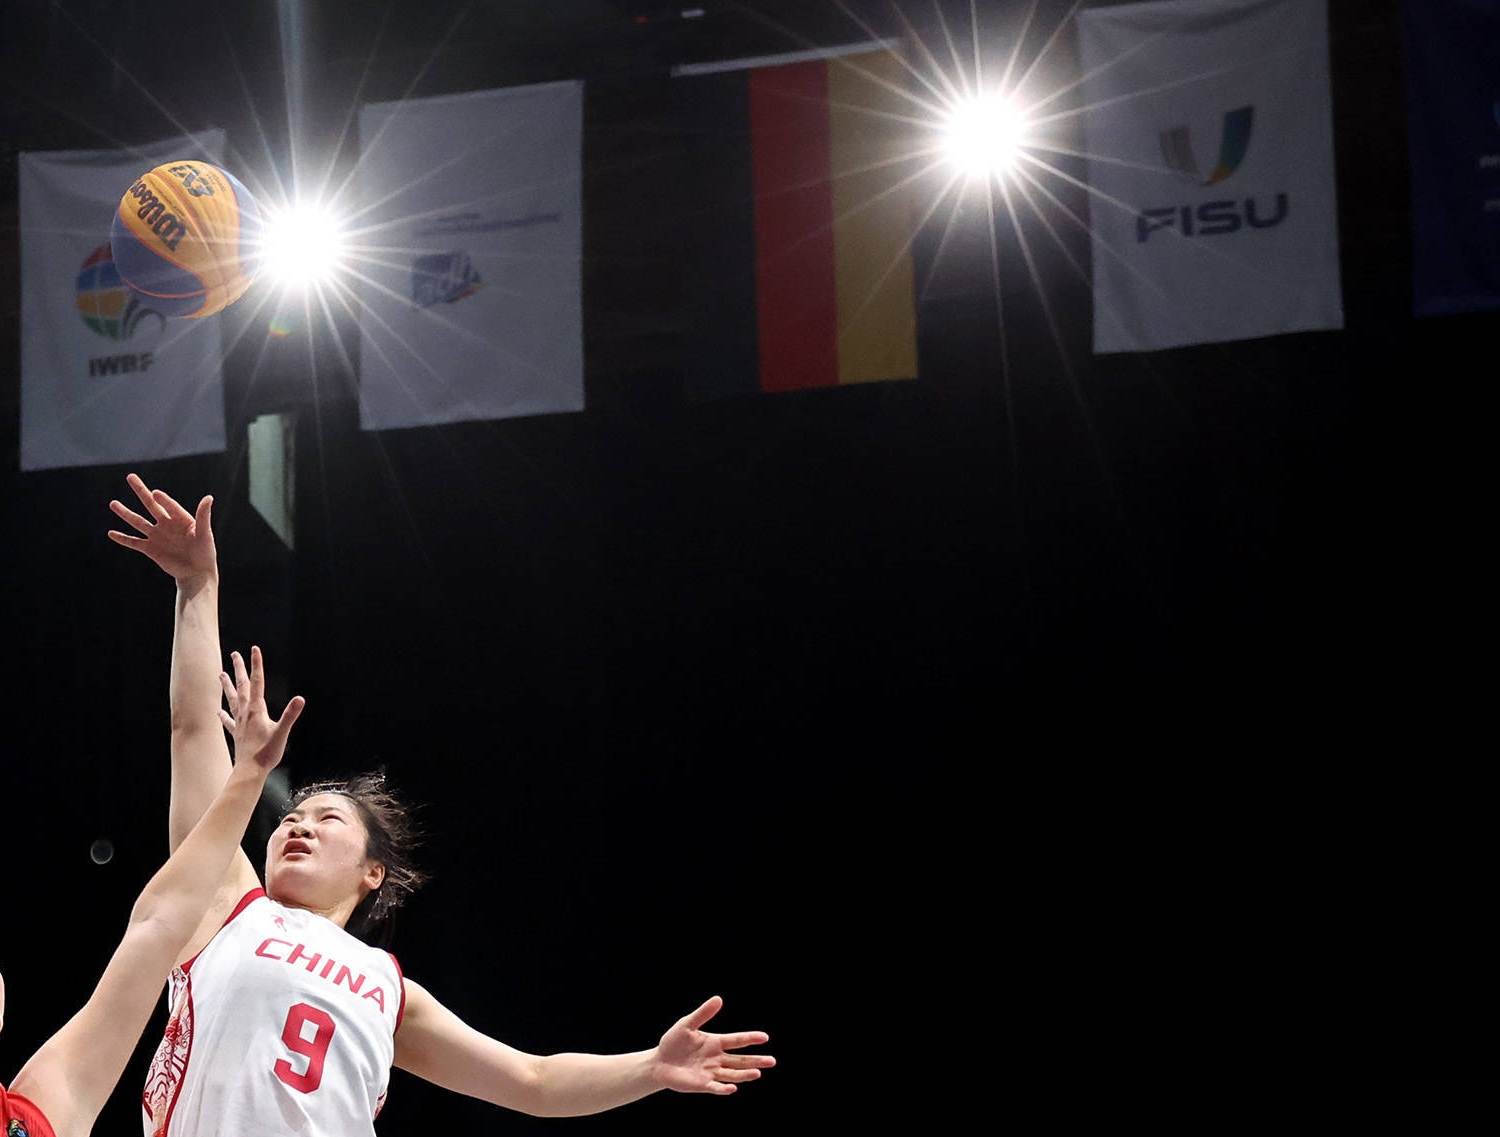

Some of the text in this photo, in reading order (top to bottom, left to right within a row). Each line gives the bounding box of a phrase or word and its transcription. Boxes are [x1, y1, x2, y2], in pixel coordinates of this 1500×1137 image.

[1132, 193, 1288, 244] FISU
[255, 936, 386, 1014] CHINA
[273, 1002, 336, 1095] 9
